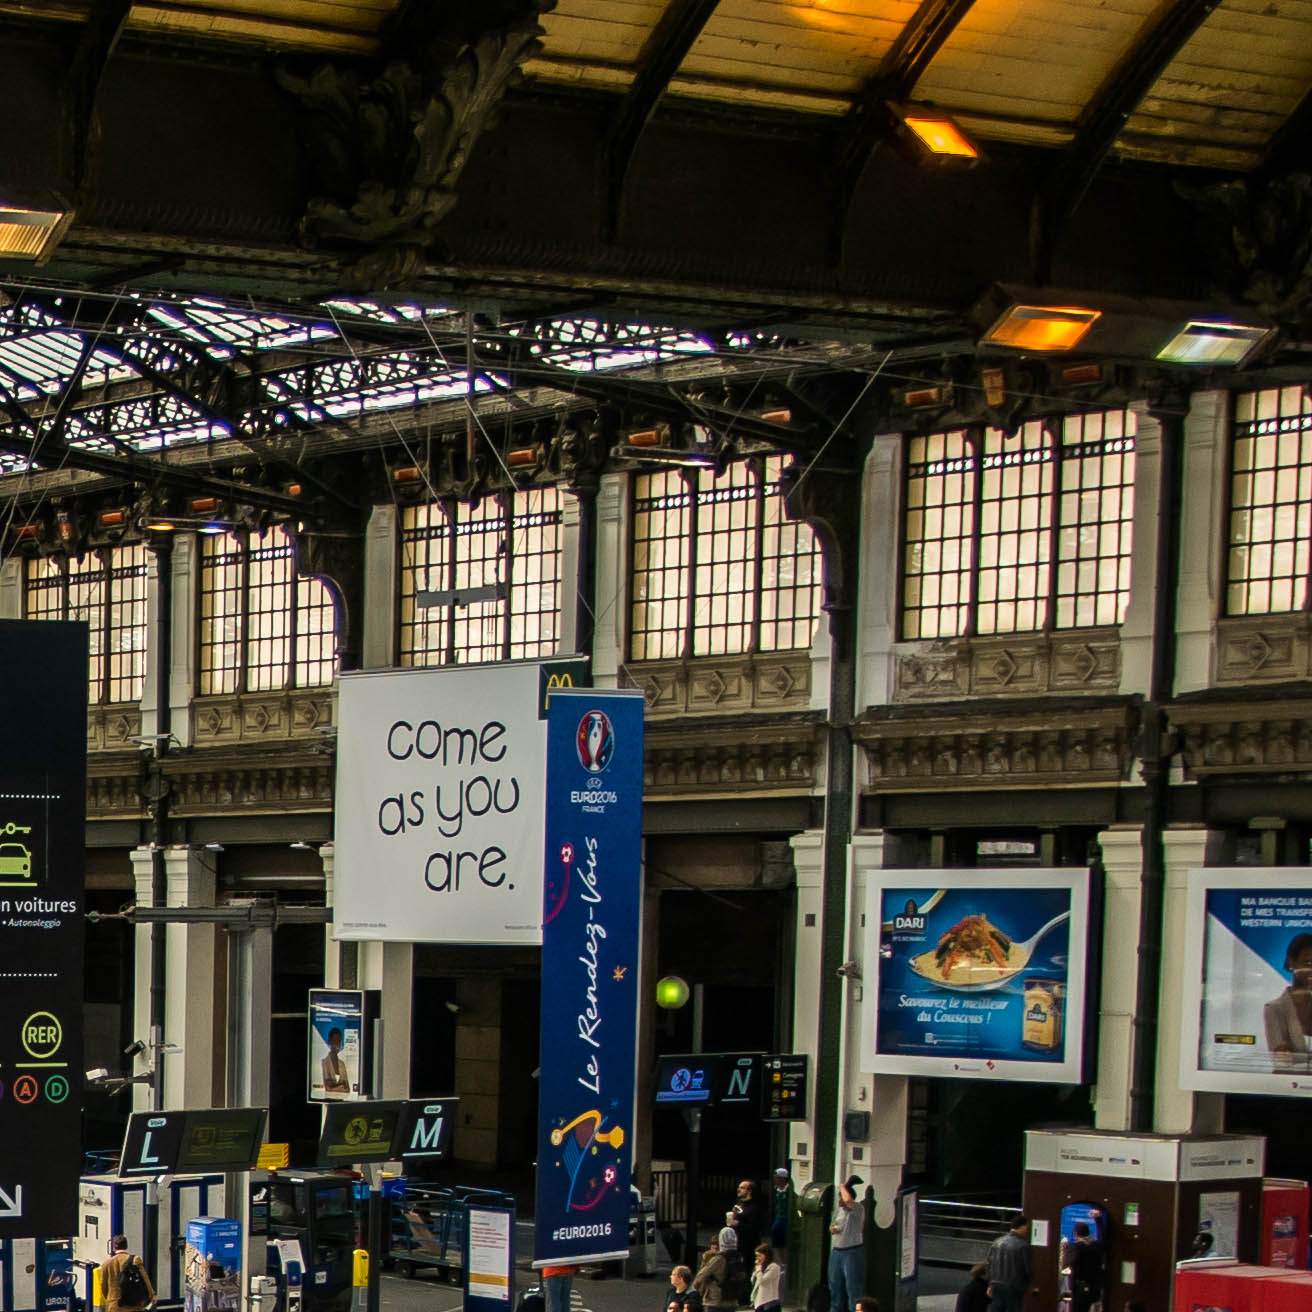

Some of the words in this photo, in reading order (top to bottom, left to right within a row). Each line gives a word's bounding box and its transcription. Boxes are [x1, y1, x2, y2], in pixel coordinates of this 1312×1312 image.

[387, 720, 508, 766] come
[378, 790, 425, 836] as
[436, 775, 520, 838] you
[425, 846, 516, 893] are.
[15, 898, 76, 913] voitures
[896, 917, 924, 929] DARI
[27, 1026, 57, 1044] RER
[578, 1055, 601, 1095] Le
[728, 1068, 752, 1095] N
[19, 1083, 31, 1097] A
[51, 1082, 62, 1097] D
[410, 1117, 444, 1149] M
[140, 1131, 160, 1164] L
[552, 1222, 612, 1241] #EURO2016
